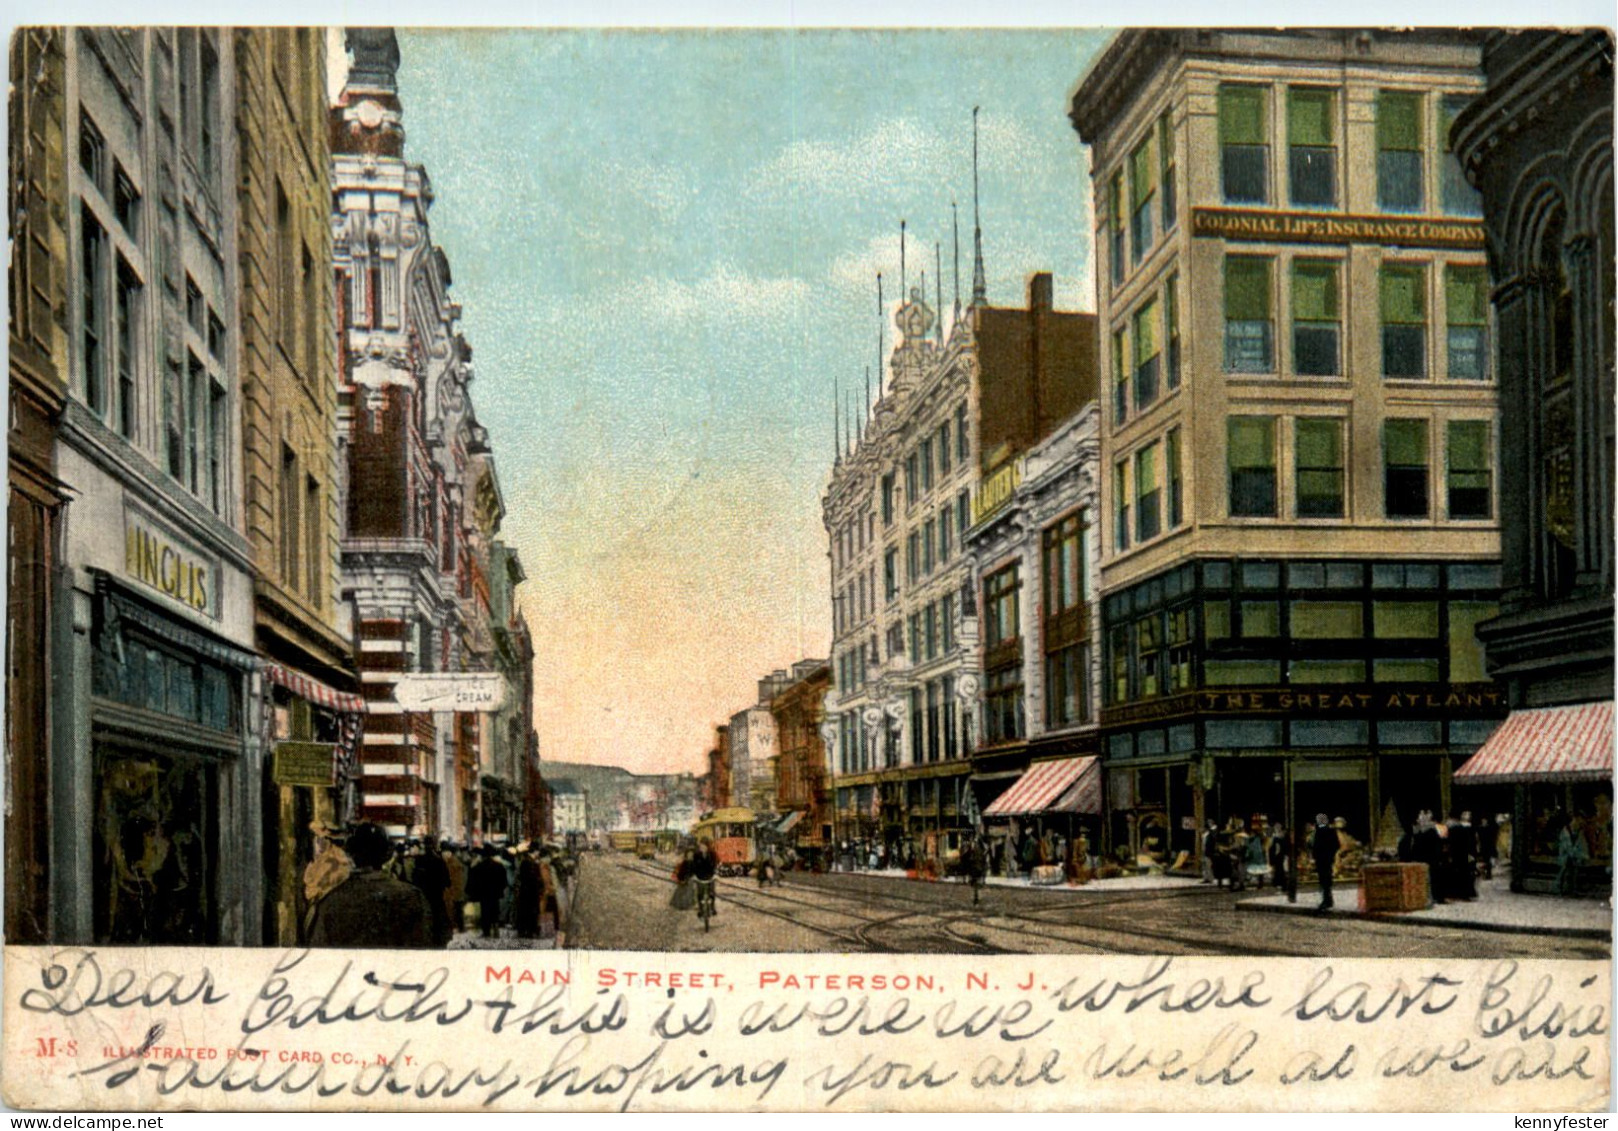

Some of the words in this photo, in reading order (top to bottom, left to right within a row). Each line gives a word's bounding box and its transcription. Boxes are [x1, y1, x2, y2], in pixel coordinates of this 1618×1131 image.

[1195, 212, 1281, 233] COLONIAL
[1327, 217, 1417, 238] INSURANCE
[456, 693, 492, 703] CREAM
[1206, 693, 1263, 709] THE
[1280, 693, 1372, 709] GREAT
[20, 950, 230, 1016] Dear
[242, 948, 474, 1034] Edith
[966, 972, 999, 990] N.
[1017, 972, 1048, 990] J.
[1287, 966, 1458, 1022] last
[227, 1048, 268, 1062] POST
[278, 1051, 323, 1063] CARD
[534, 1035, 788, 1112] hoping
[805, 1053, 958, 1105] you
[1083, 1023, 1255, 1086] well
